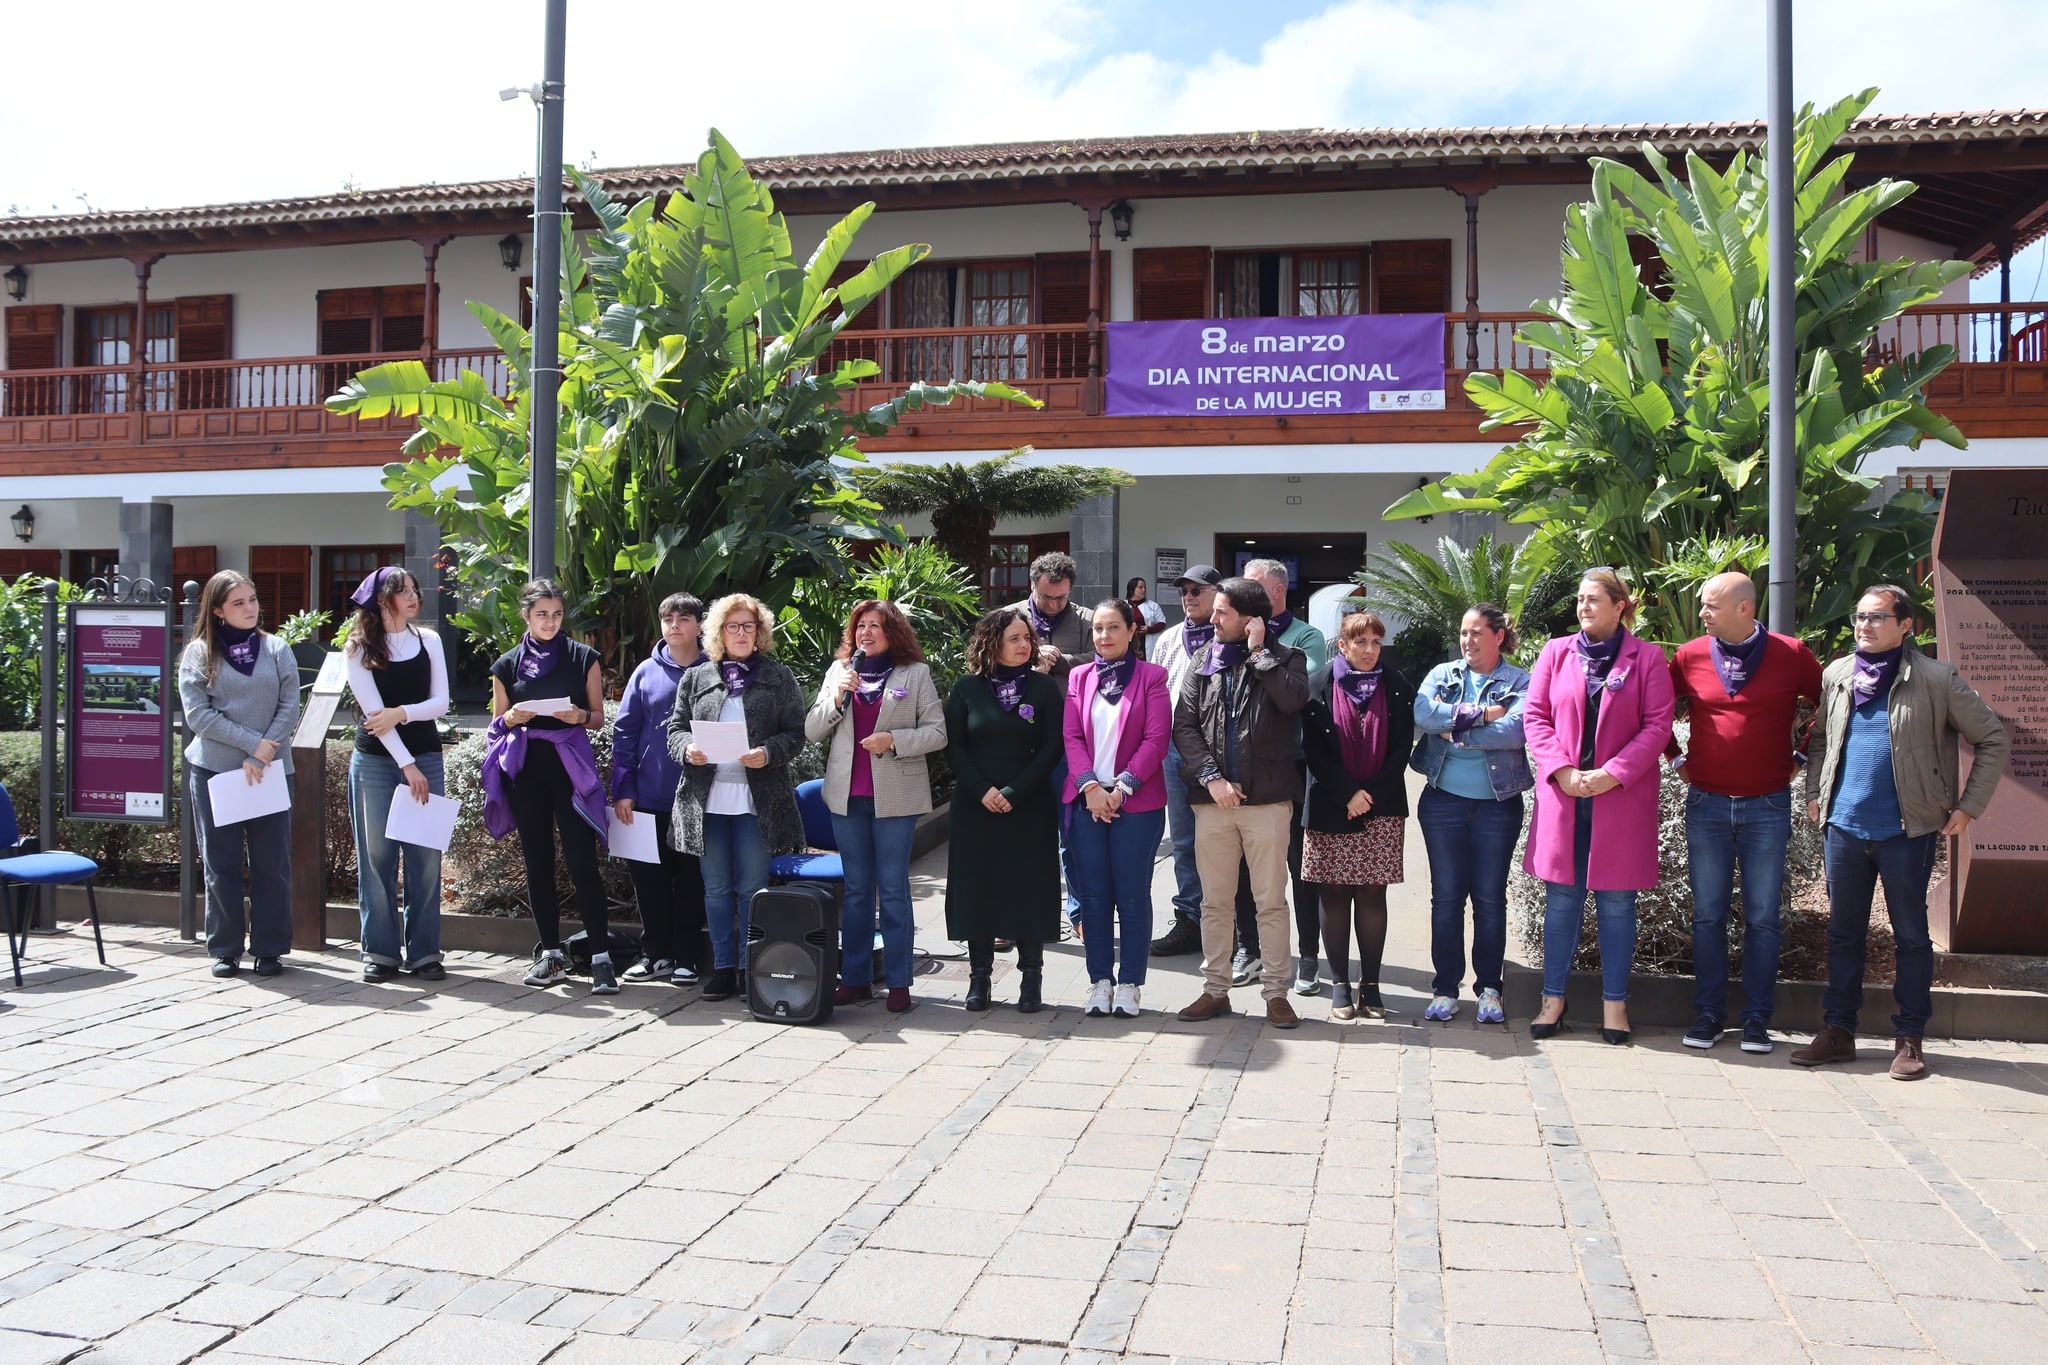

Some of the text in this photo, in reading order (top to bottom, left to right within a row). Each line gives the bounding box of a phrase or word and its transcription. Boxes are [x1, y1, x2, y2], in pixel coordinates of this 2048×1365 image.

[1201, 327, 1345, 355] 8 de marzo
[1148, 363, 1400, 386] DIA INTERNACIONAL
[1196, 391, 1342, 410] DE LA MUJER
[2007, 497, 2048, 516] Tac
